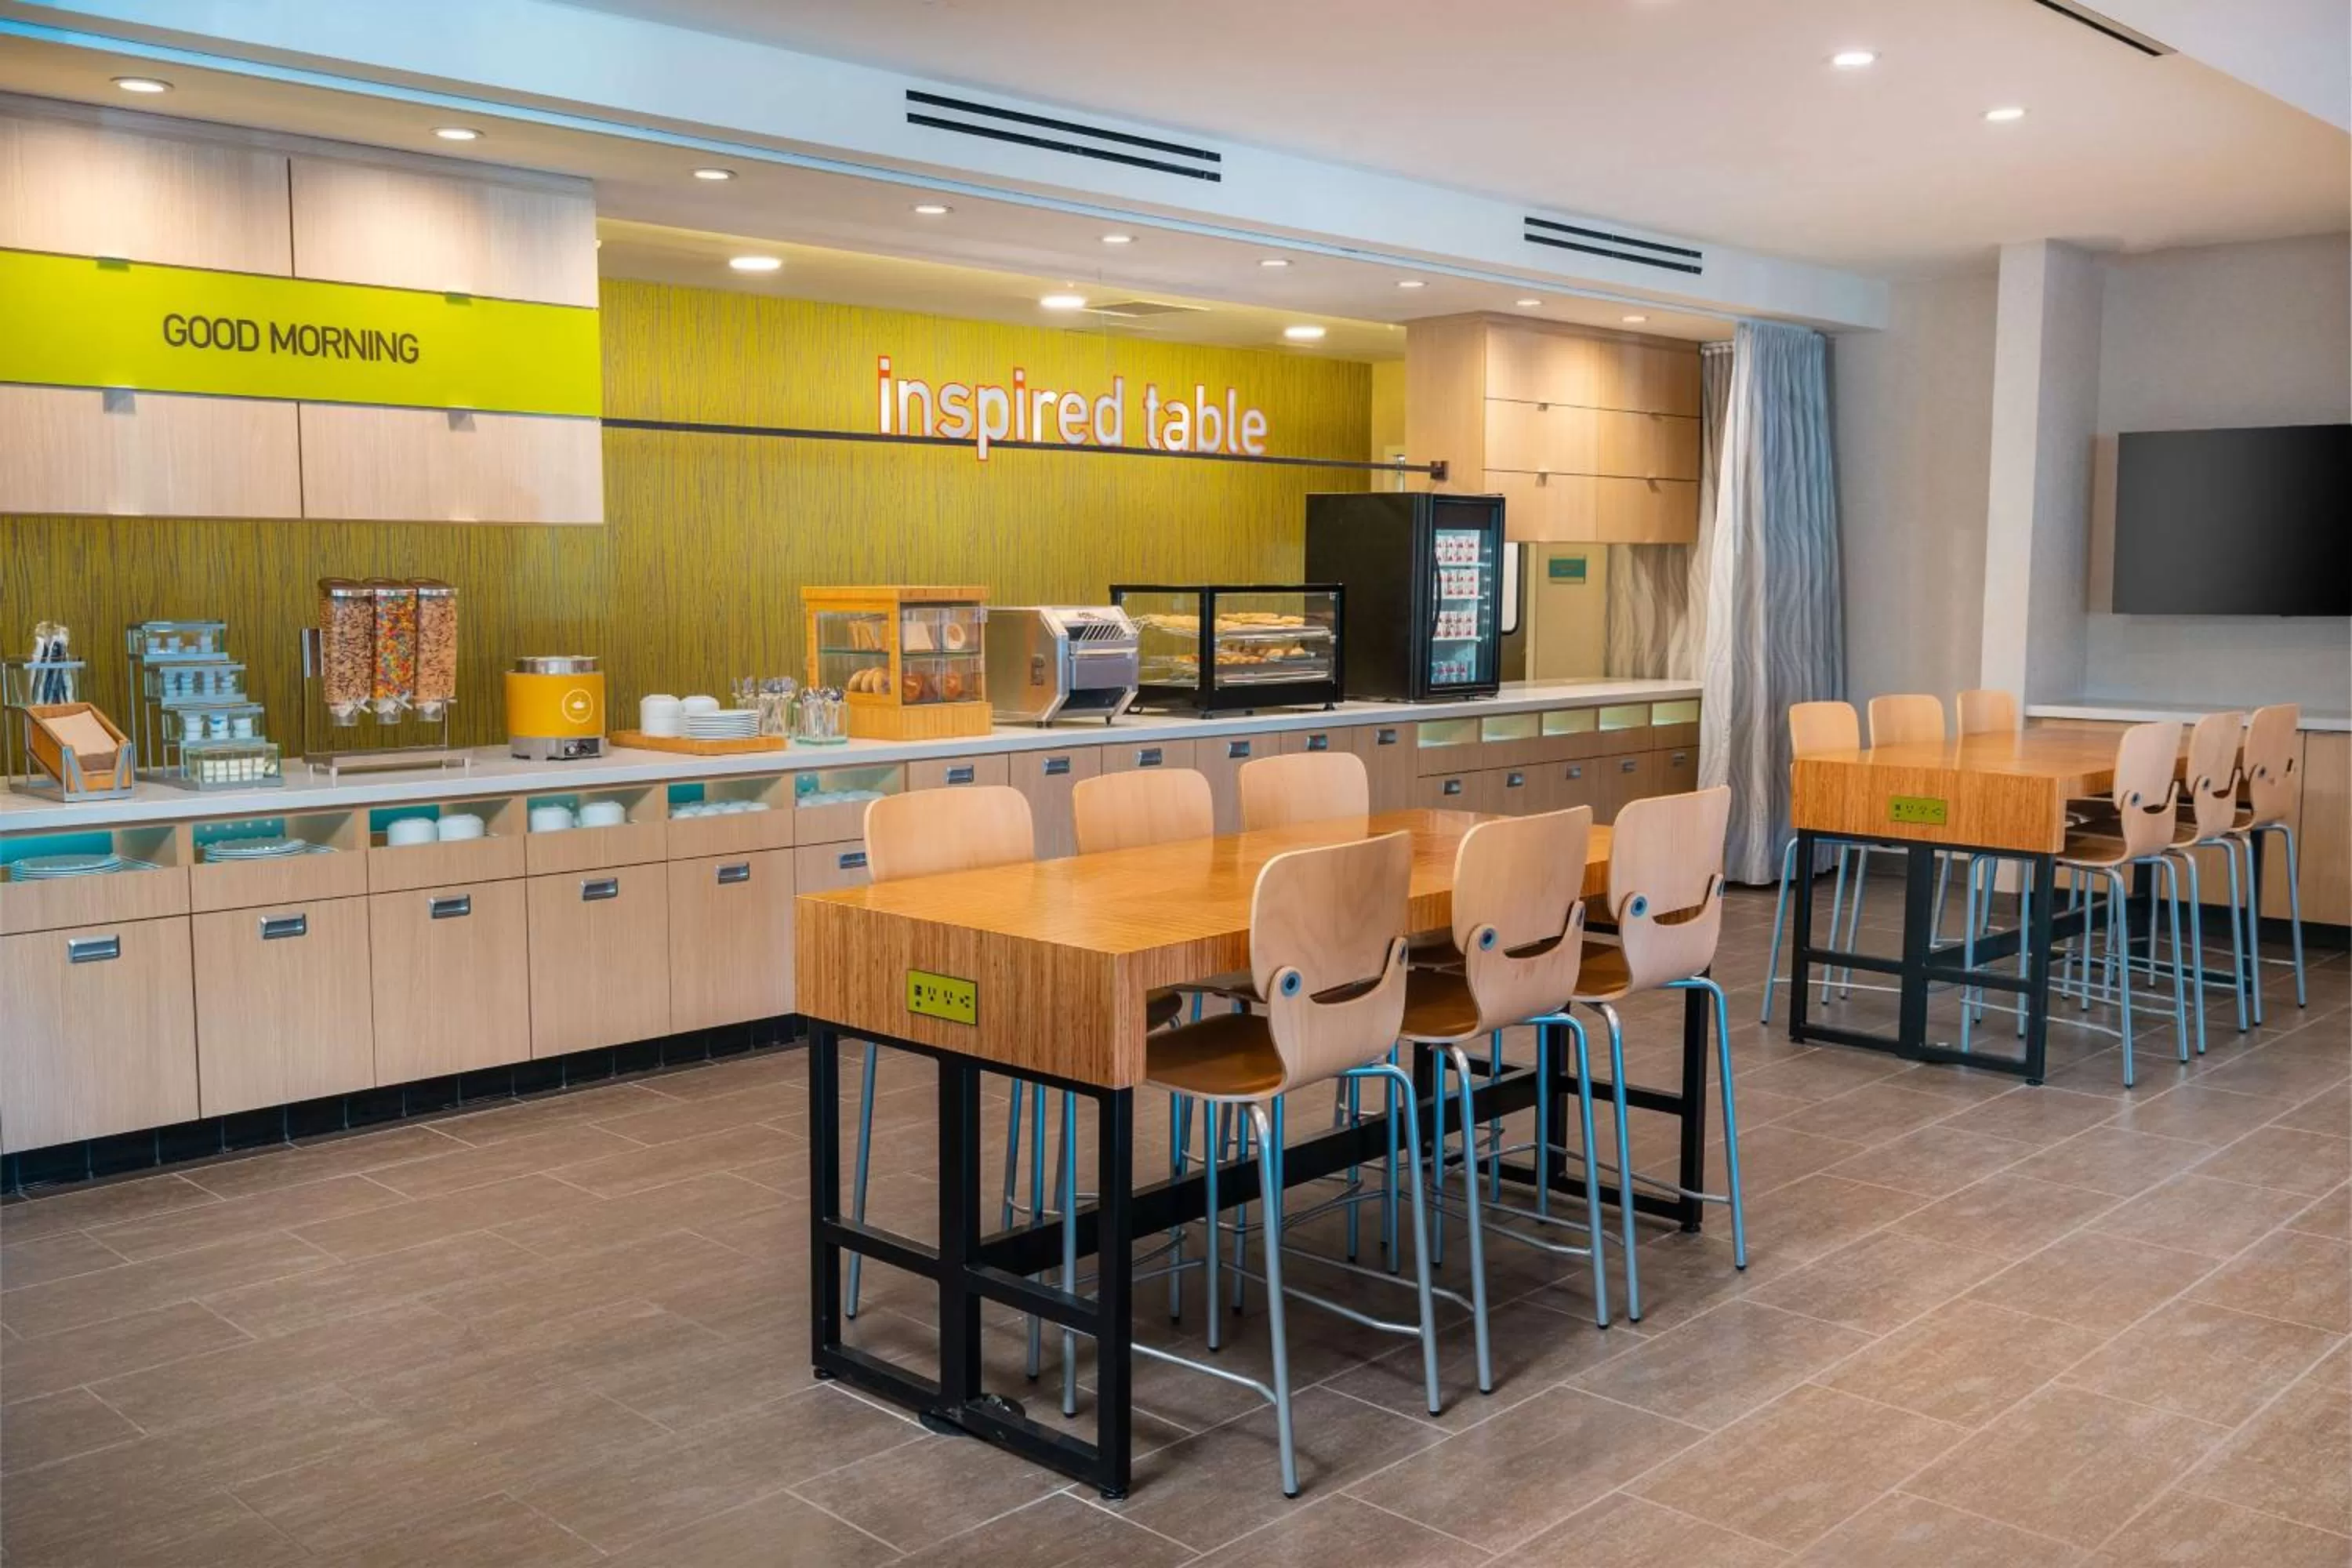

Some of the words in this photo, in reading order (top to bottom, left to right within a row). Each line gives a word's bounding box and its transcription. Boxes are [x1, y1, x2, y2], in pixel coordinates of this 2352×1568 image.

[162, 314, 260, 352] GOOD
[269, 321, 420, 365] MORNING
[877, 355, 1124, 461] inspired
[1143, 382, 1268, 455] table
